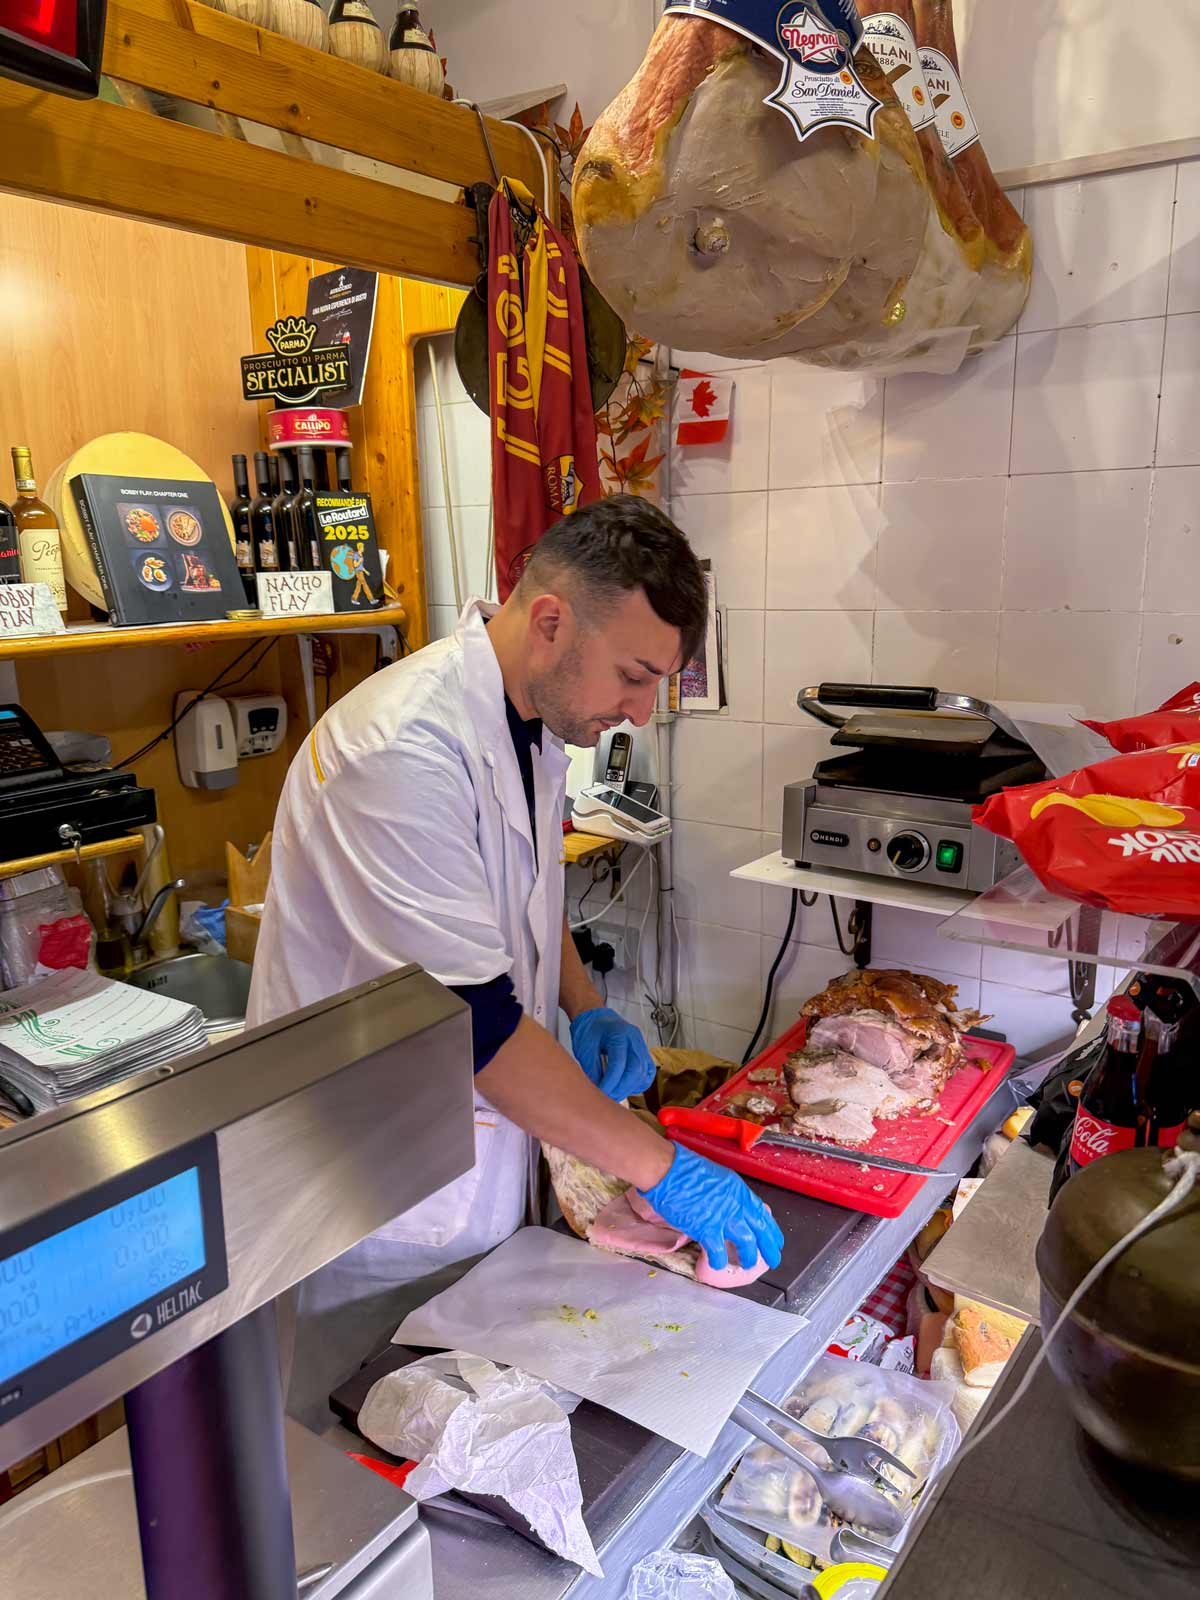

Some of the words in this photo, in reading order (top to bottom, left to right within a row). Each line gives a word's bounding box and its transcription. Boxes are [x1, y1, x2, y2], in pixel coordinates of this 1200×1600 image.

[866, 42, 912, 64] ILLANI
[877, 58, 895, 66] 886
[280, 340, 306, 350] PARMA
[243, 357, 299, 371] PROSCIUTTO
[302, 356, 312, 364] DI
[314, 351, 346, 362] PARMA
[246, 360, 349, 391] SPECIALIST
[295, 421, 330, 431] CALLIPO
[547, 466, 560, 507] ROMA
[324, 525, 369, 540] 2025
[265, 576, 322, 593] NACHO
[0, 586, 35, 608] OBBY
[269, 592, 313, 611] FLAY
[0, 606, 35, 629] FLAY
[820, 834, 843, 843] HENDI
[1107, 831, 1166, 857] OK
[1150, 840, 1200, 864] RIK
[1076, 1116, 1119, 1153] Cola
[156, 1281, 204, 1325] HELMAC
